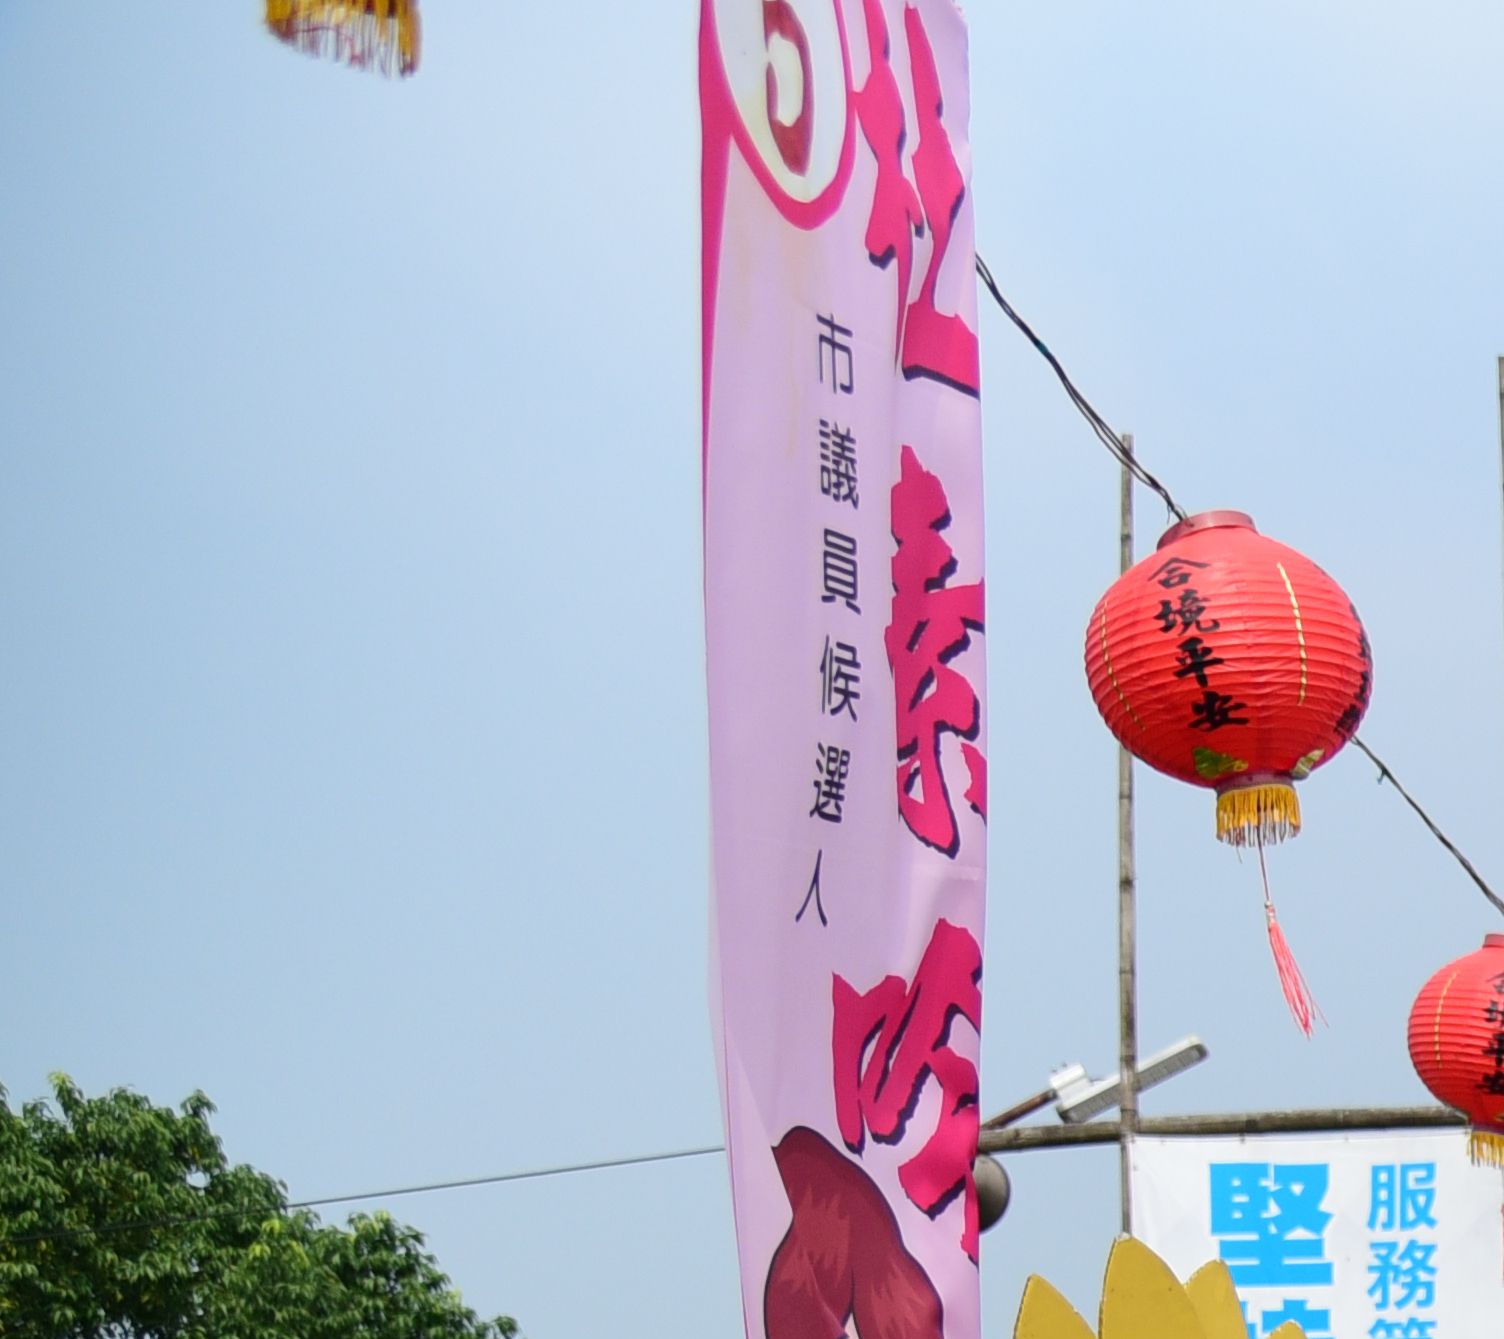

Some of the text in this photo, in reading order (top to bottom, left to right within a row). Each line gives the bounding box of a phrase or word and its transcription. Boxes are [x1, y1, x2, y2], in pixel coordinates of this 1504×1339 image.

[795, 312, 863, 928] 市議員候選人
[1147, 556, 1250, 732] 合境平安
